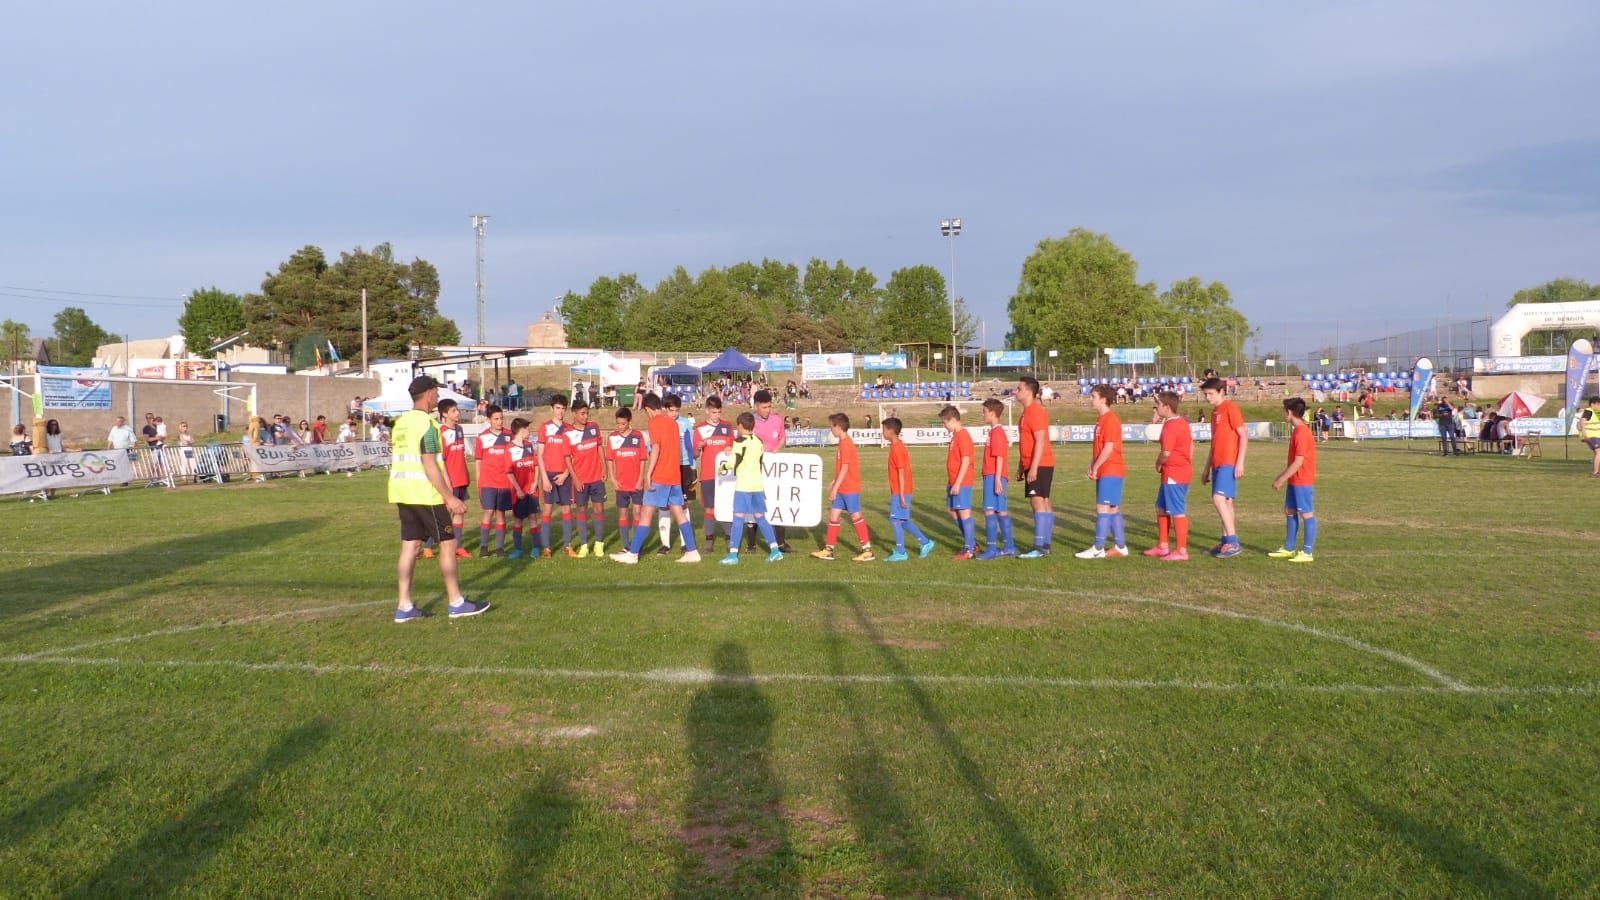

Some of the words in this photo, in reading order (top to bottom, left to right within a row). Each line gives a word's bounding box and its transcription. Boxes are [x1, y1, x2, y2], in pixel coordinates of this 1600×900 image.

[852, 431, 904, 440] Burgs
[916, 430, 953, 439] Burg
[256, 446, 308, 461] Burgos
[313, 445, 354, 461] Burgos
[362, 444, 393, 458] Burgo
[23, 453, 117, 478] Burgos
[719, 460, 819, 480] SMPRE
[776, 485, 801, 502] IR
[770, 507, 800, 523] AY
